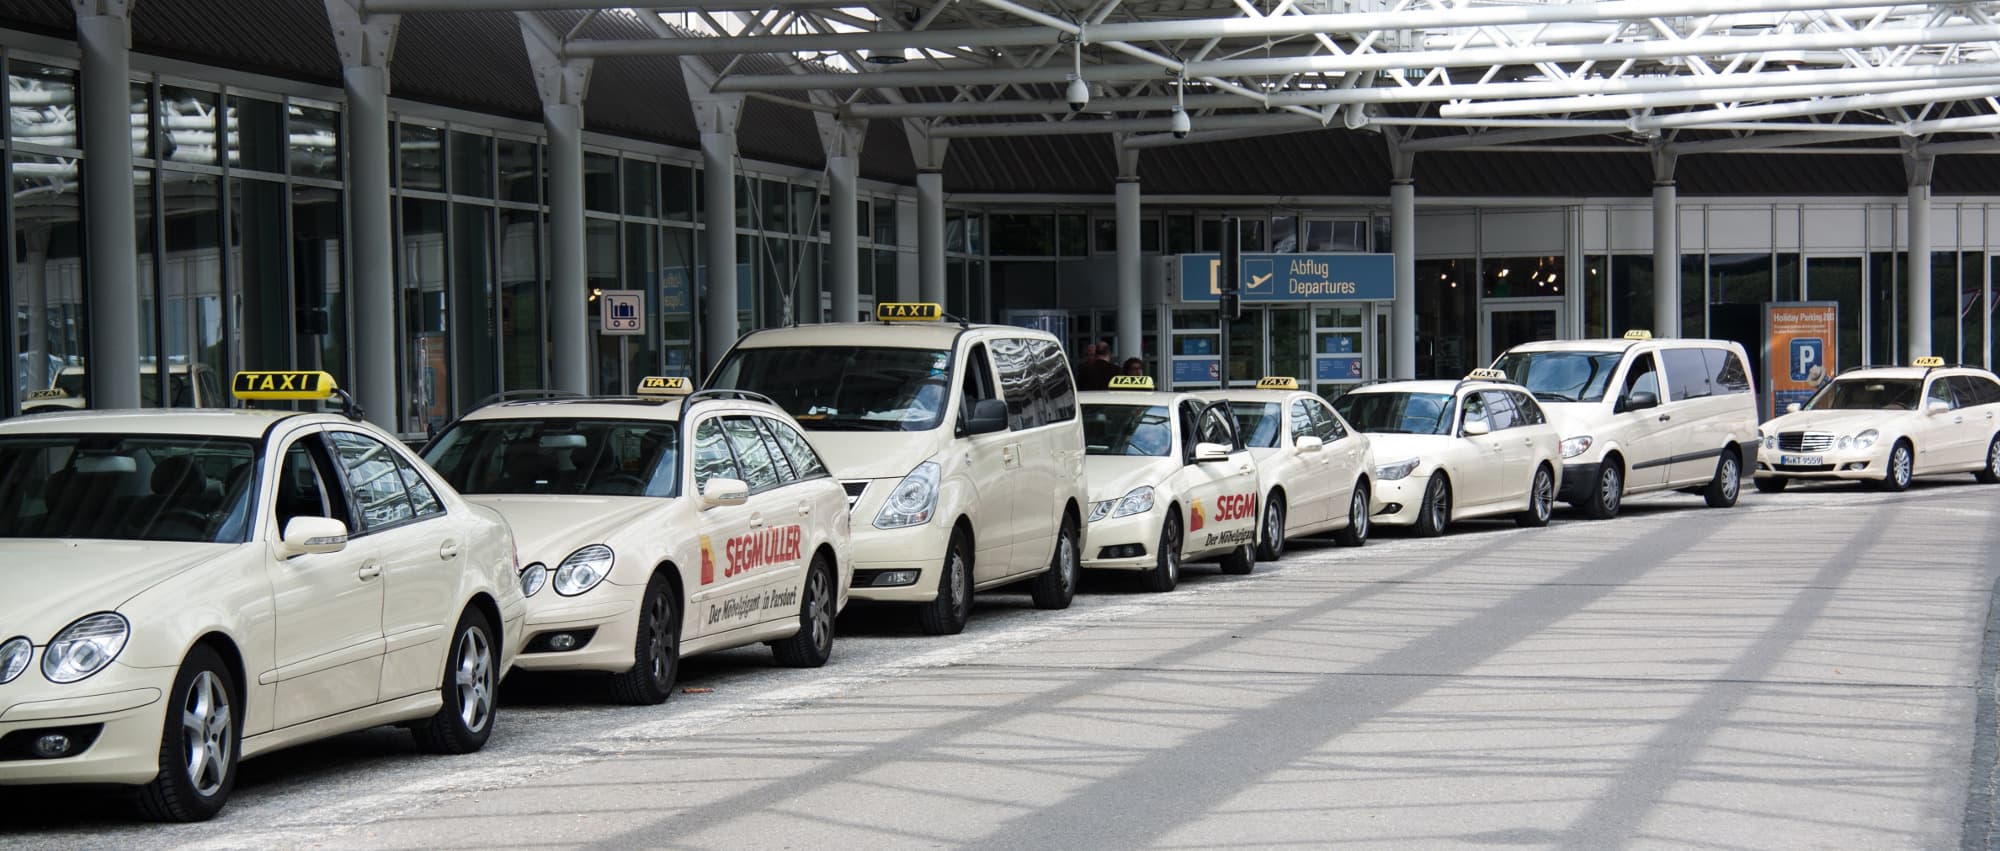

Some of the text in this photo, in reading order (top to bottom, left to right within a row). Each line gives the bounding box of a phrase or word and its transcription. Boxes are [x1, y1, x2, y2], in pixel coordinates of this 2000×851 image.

[1289, 259, 1329, 278] Abflug
[1289, 279, 1356, 297] Departures
[886, 304, 928, 316] TAXI
[1774, 312, 1798, 323] Holiday
[1800, 312, 1822, 322] Parking
[1800, 345, 1814, 375] P
[1115, 375, 1147, 385] TAXI
[1474, 370, 1501, 378] TAXI
[246, 374, 308, 390] TAXI
[646, 378, 683, 388] TAXI
[1262, 378, 1292, 386] TAXI
[1215, 493, 1255, 522] SEGM
[1205, 533, 1218, 547] Der
[708, 586, 798, 624] Der Möbelgigant in Parsdorf
